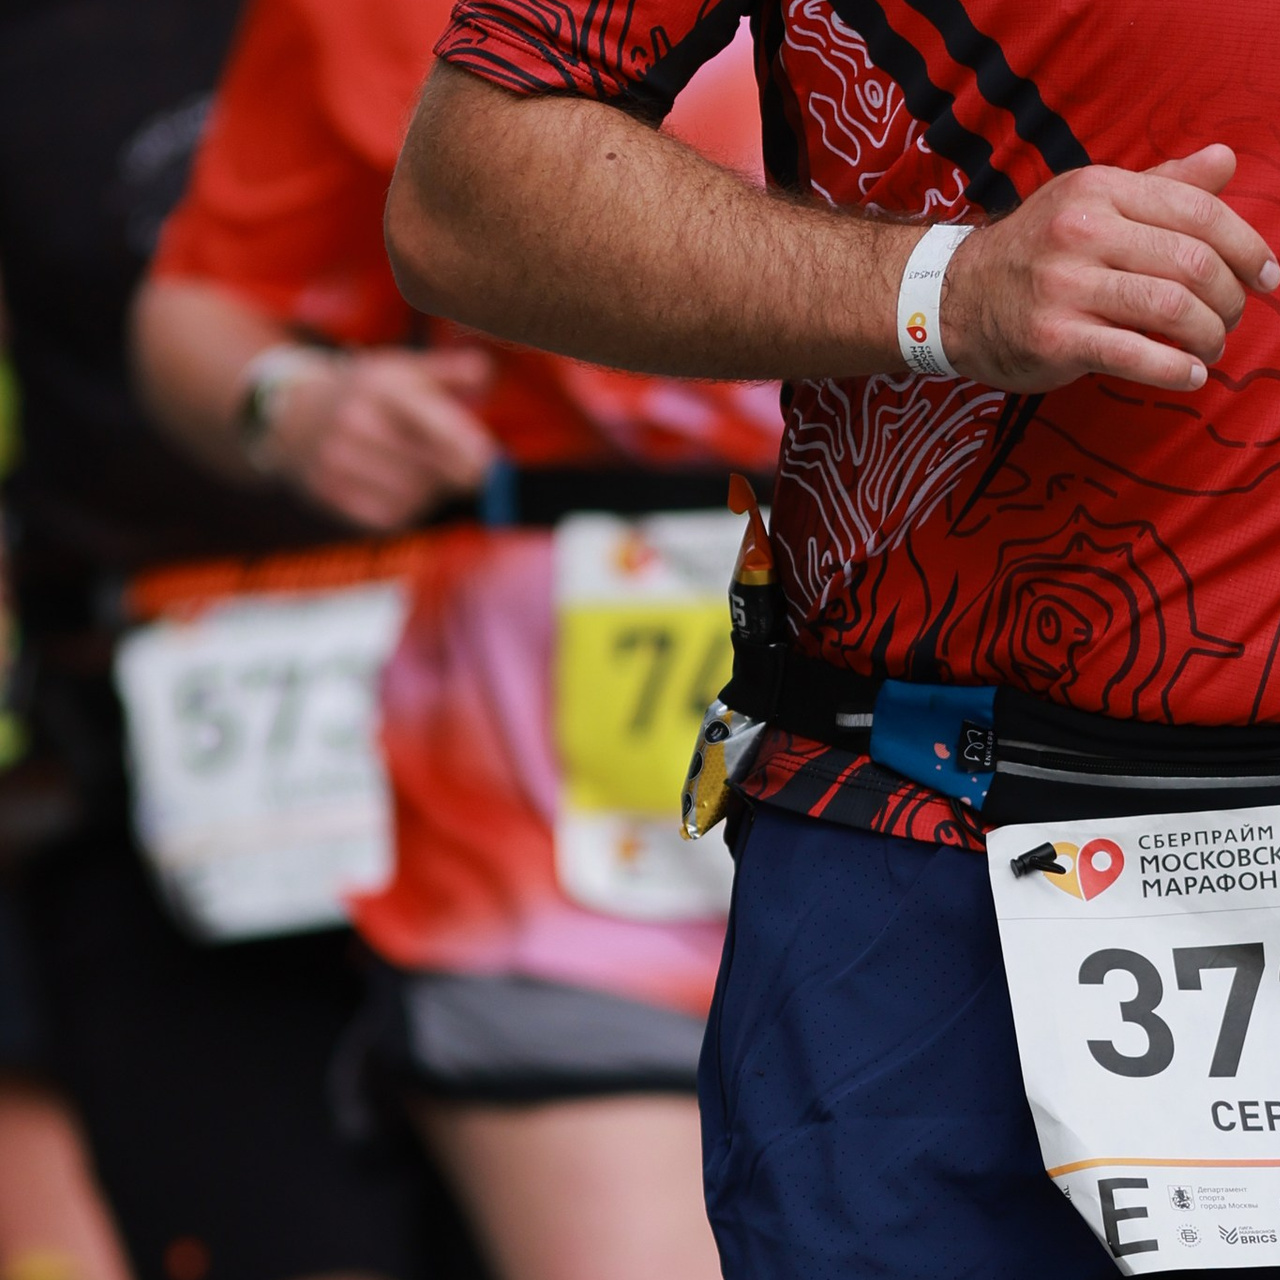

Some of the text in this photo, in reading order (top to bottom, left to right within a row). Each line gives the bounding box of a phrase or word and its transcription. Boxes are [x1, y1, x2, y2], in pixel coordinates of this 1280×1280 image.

[1138, 823, 1273, 850] СБЕРПРАЙМ
[1142, 869, 1278, 898] МАРАФОН
[1197, 1186, 1247, 1194] Департамент
[1240, 1234, 1278, 1244] BRICS
